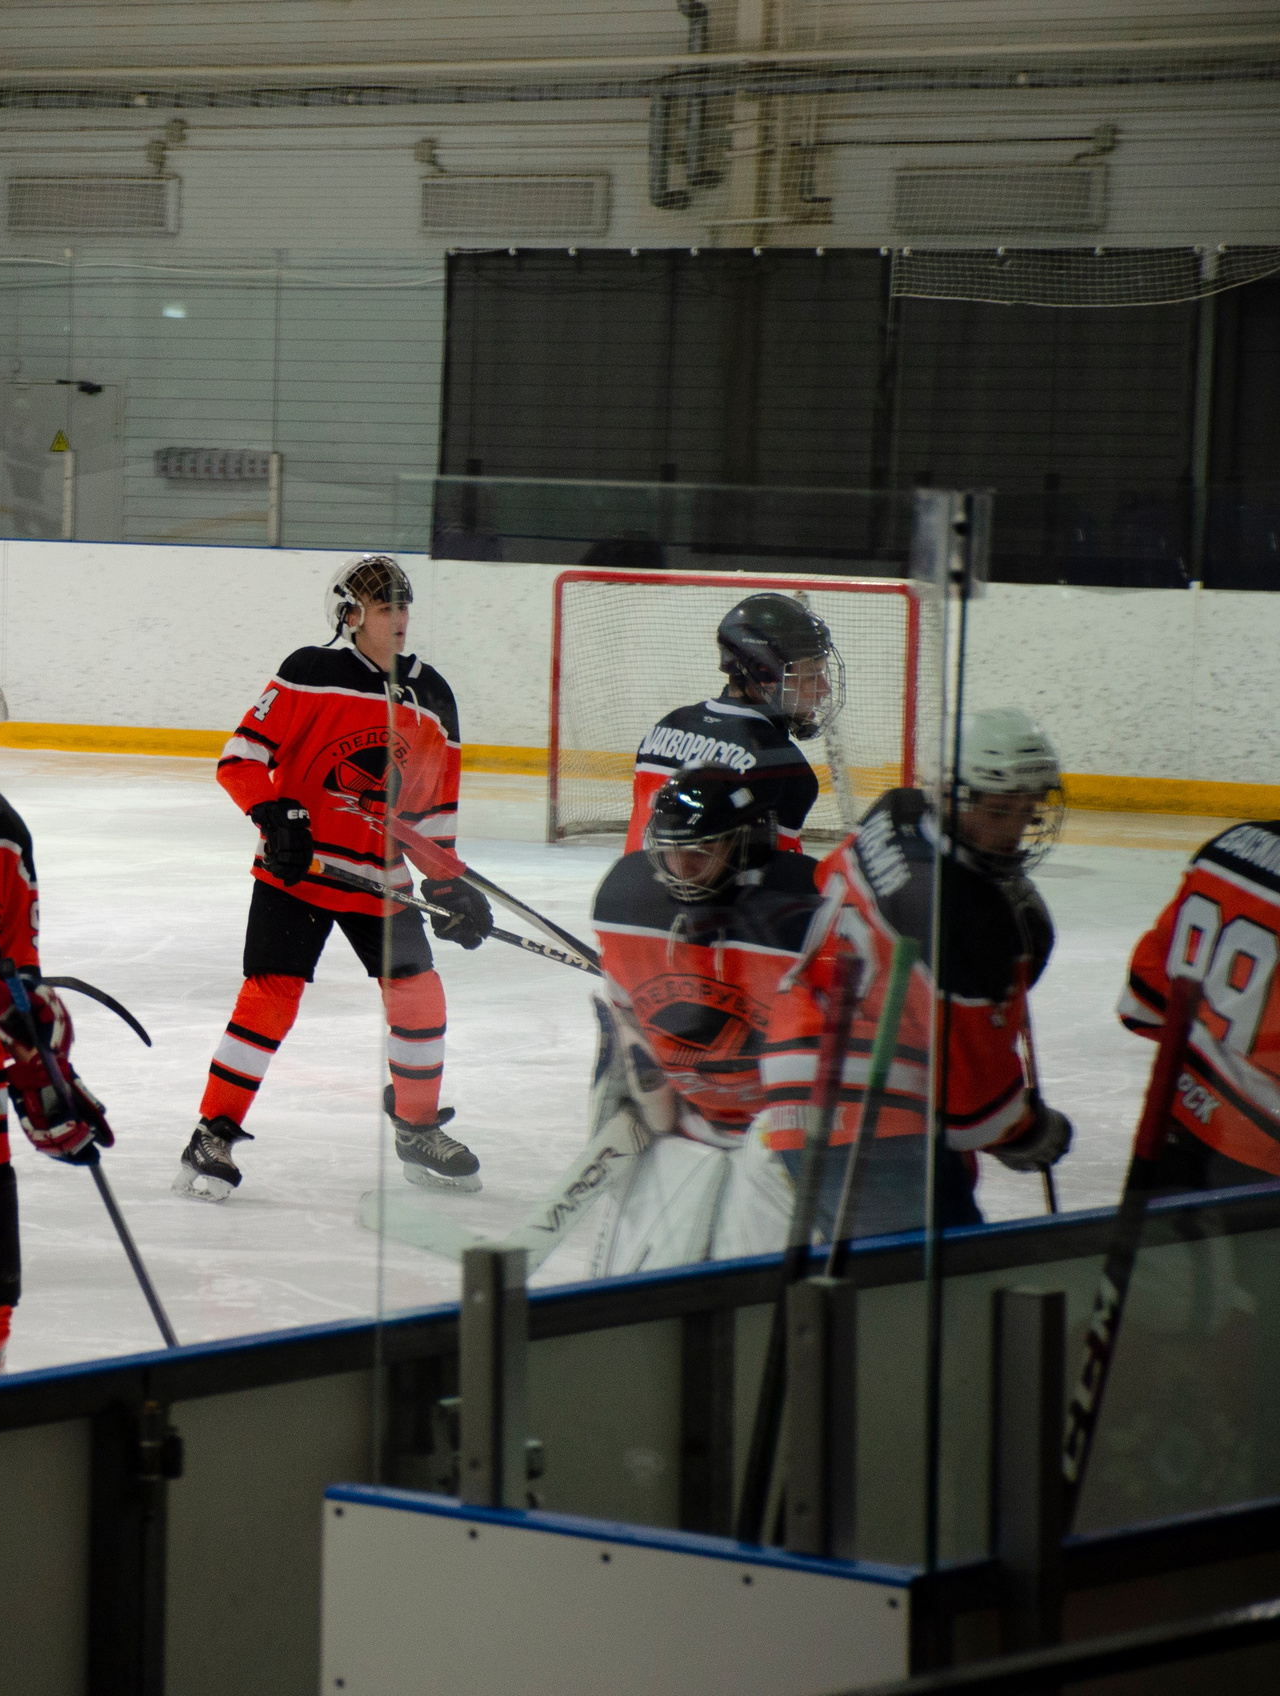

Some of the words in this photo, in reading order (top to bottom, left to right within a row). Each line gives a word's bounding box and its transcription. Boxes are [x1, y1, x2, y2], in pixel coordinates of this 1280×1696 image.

[253, 688, 280, 722] 4
[519, 936, 590, 971] CCM
[528, 1146, 634, 1233] VAPOR
